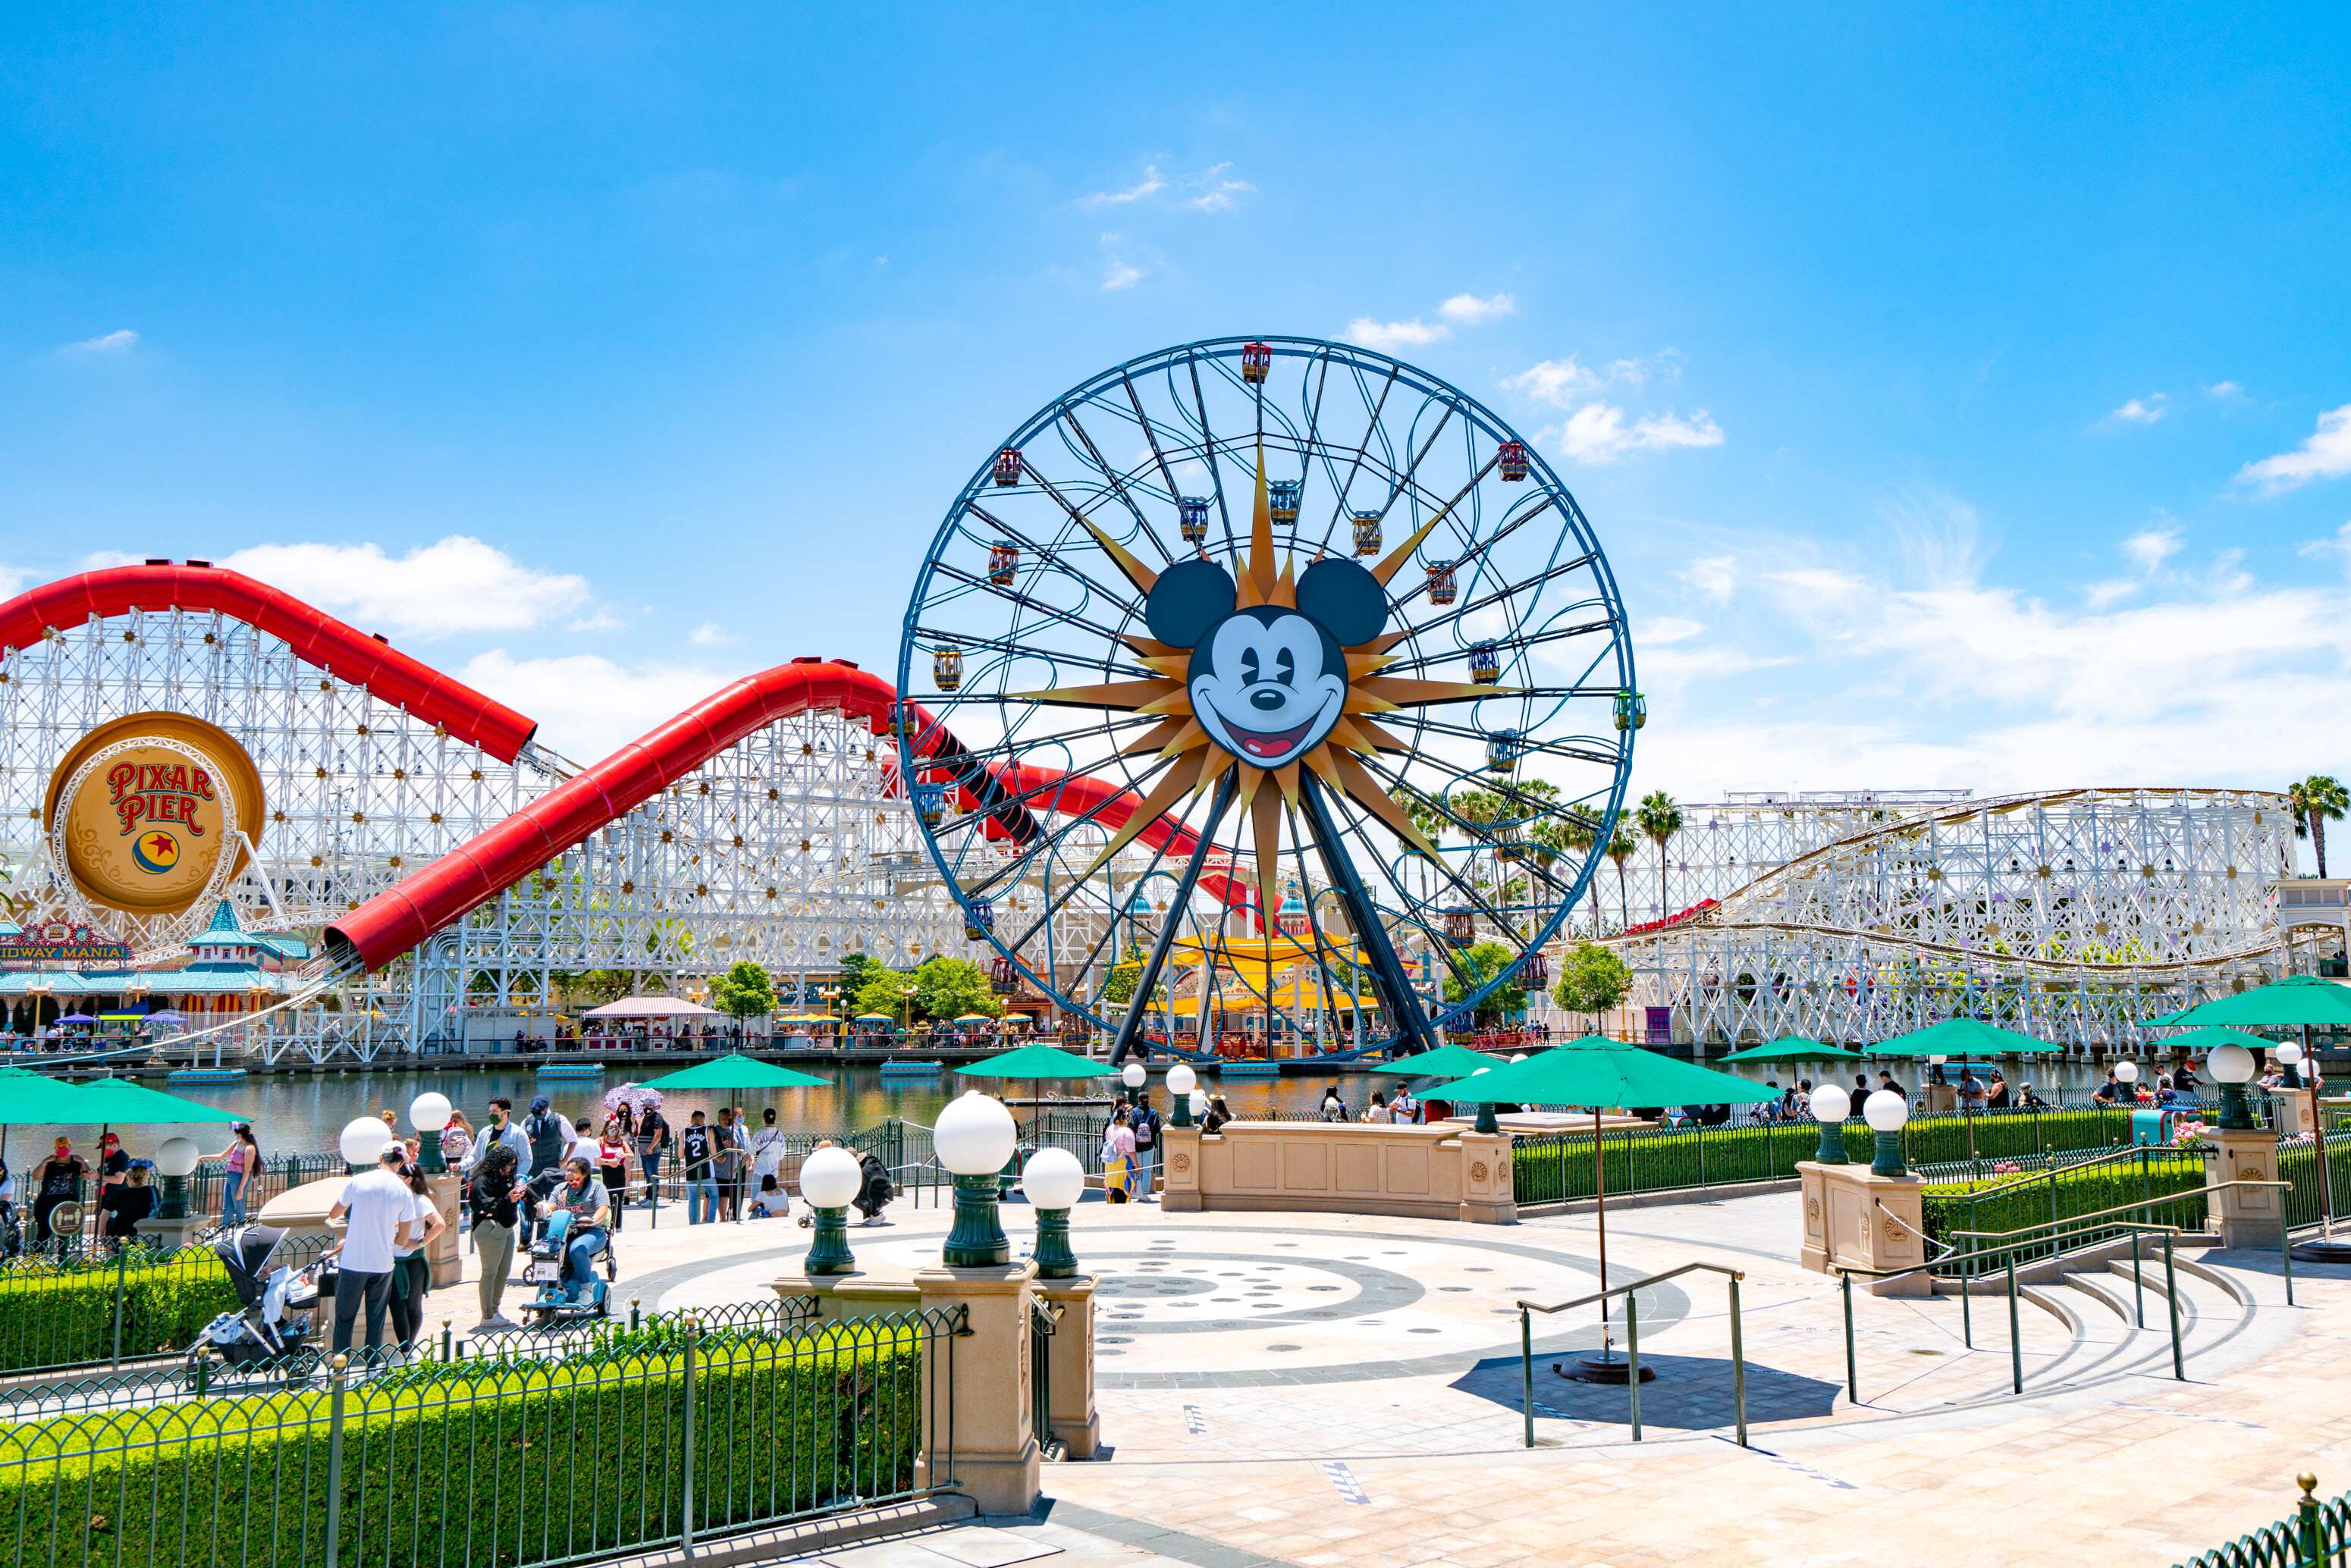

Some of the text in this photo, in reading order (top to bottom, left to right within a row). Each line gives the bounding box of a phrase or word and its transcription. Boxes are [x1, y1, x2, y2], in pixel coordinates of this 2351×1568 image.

[107, 761, 215, 804] PIXAR
[117, 793, 205, 837] PIER
[0, 948, 124, 958] IDWAY MANIA!
[686, 1133, 705, 1143] LEONARD
[691, 1140, 702, 1157] 2
